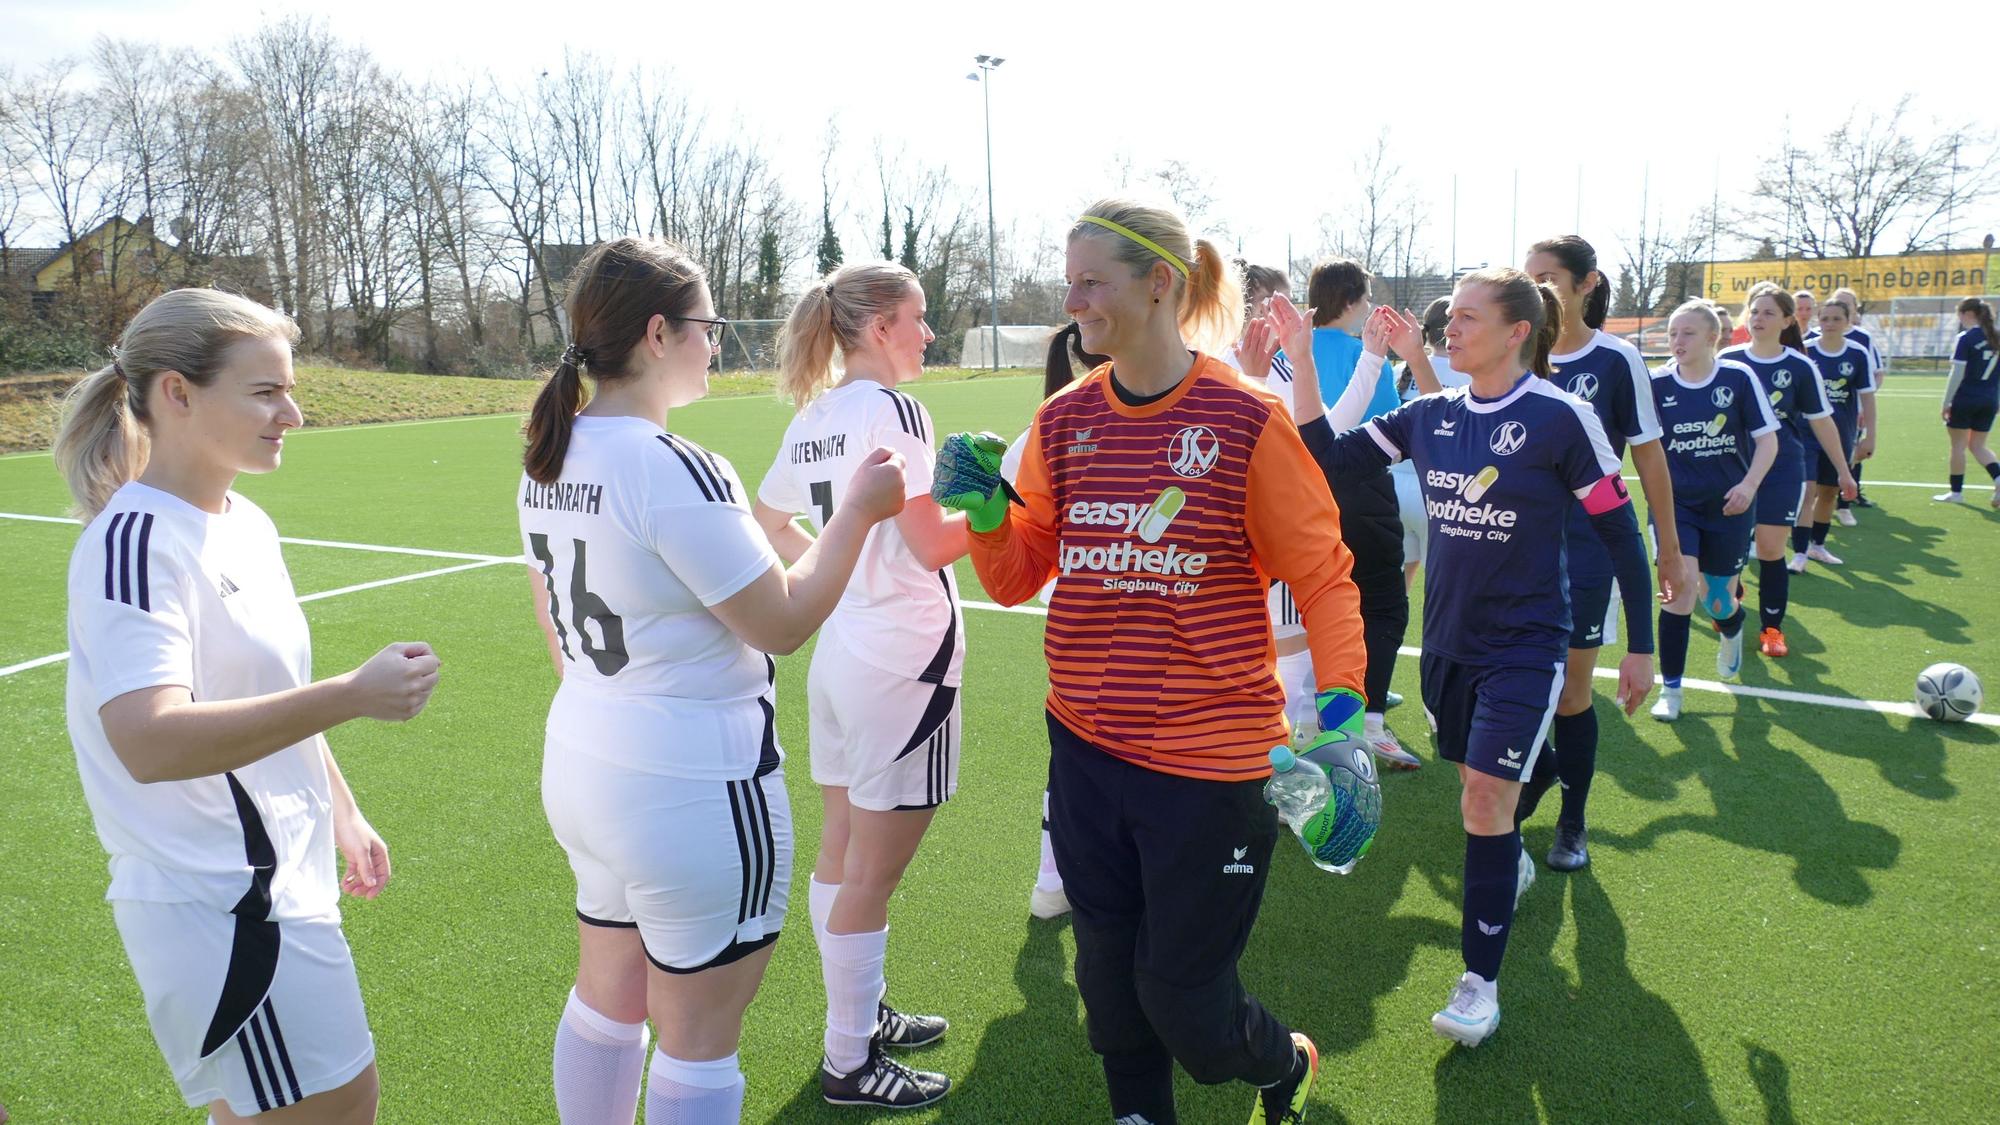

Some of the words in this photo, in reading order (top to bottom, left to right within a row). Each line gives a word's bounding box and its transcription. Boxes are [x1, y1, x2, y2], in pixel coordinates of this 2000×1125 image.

[1983, 350, 2000, 380] 7
[1433, 428, 1455, 437] erima
[1673, 420, 1713, 434] easy
[1068, 443, 1098, 454] erima
[1667, 434, 1736, 453] Apotheke
[1188, 468, 1201, 476] 04
[1426, 469, 1475, 495] easy
[1611, 474, 1629, 499] C
[523, 480, 603, 515] ALTENRATH
[1068, 500, 1151, 534] easy
[1439, 524, 1483, 540] Siegburg
[1486, 530, 1511, 543] City
[1102, 578, 1168, 597] Siegburg
[1173, 581, 1200, 597] City
[528, 532, 630, 677] 16
[1223, 863, 1254, 874] erima
